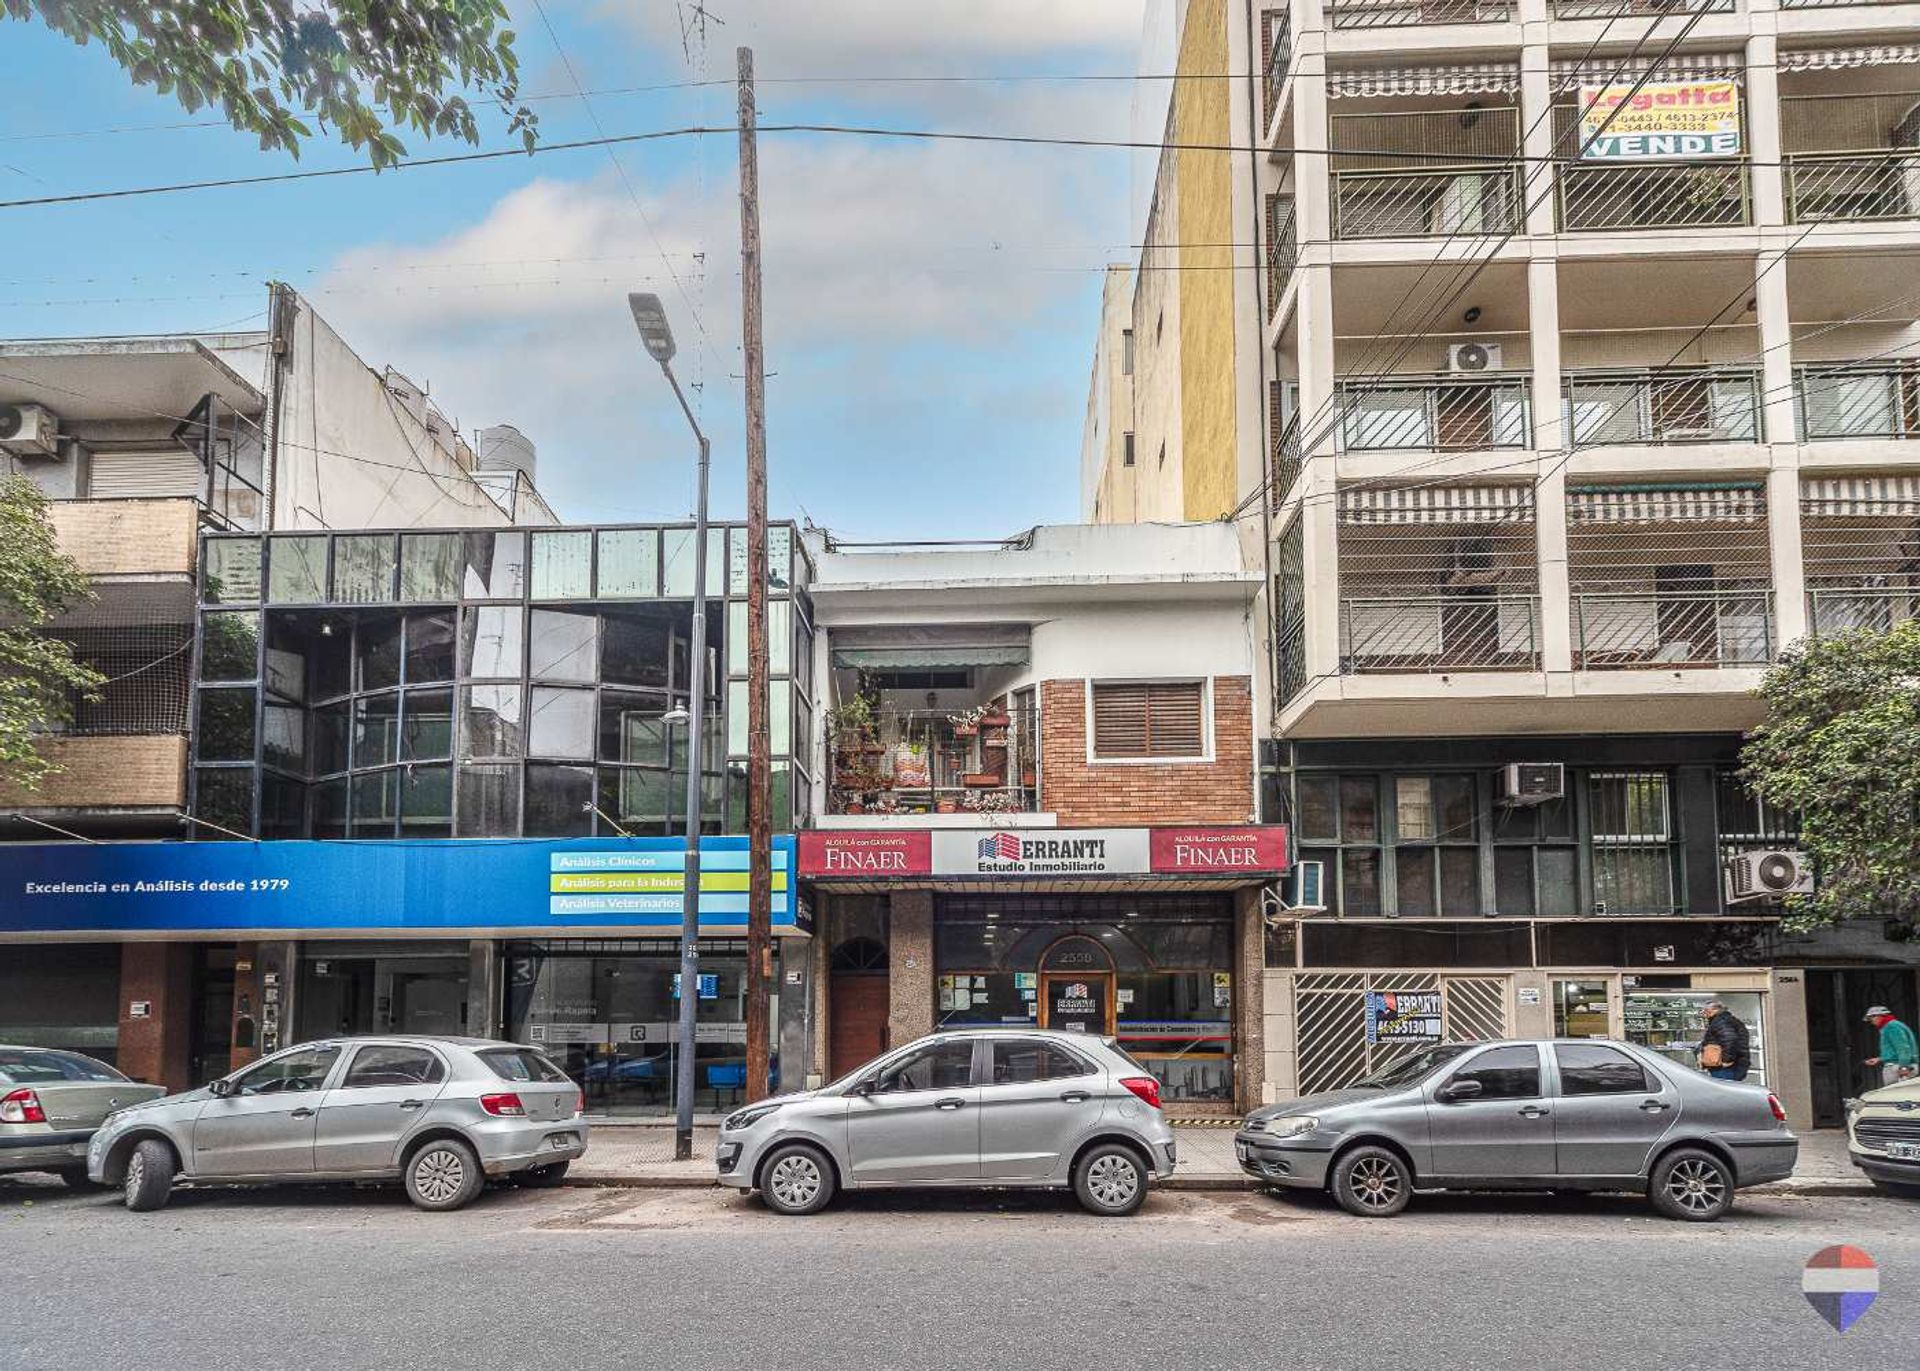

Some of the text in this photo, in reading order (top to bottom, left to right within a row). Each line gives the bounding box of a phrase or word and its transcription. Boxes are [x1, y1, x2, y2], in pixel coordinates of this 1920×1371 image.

[1591, 134, 1736, 155] VENDE
[1022, 839, 1105, 859] ERRANTI
[1174, 844, 1259, 866] FINAER
[559, 856, 656, 868] Análisis Clínicos
[825, 848, 907, 870] FINAER
[978, 861, 1105, 872] Estudio Inmobiliario
[25, 878, 290, 894] Excelencia en Análisis desde 1979
[559, 877, 606, 889] Análisis
[608, 880, 635, 889] para
[637, 878, 649, 888] la
[559, 897, 681, 910] Análisis Veterinarios
